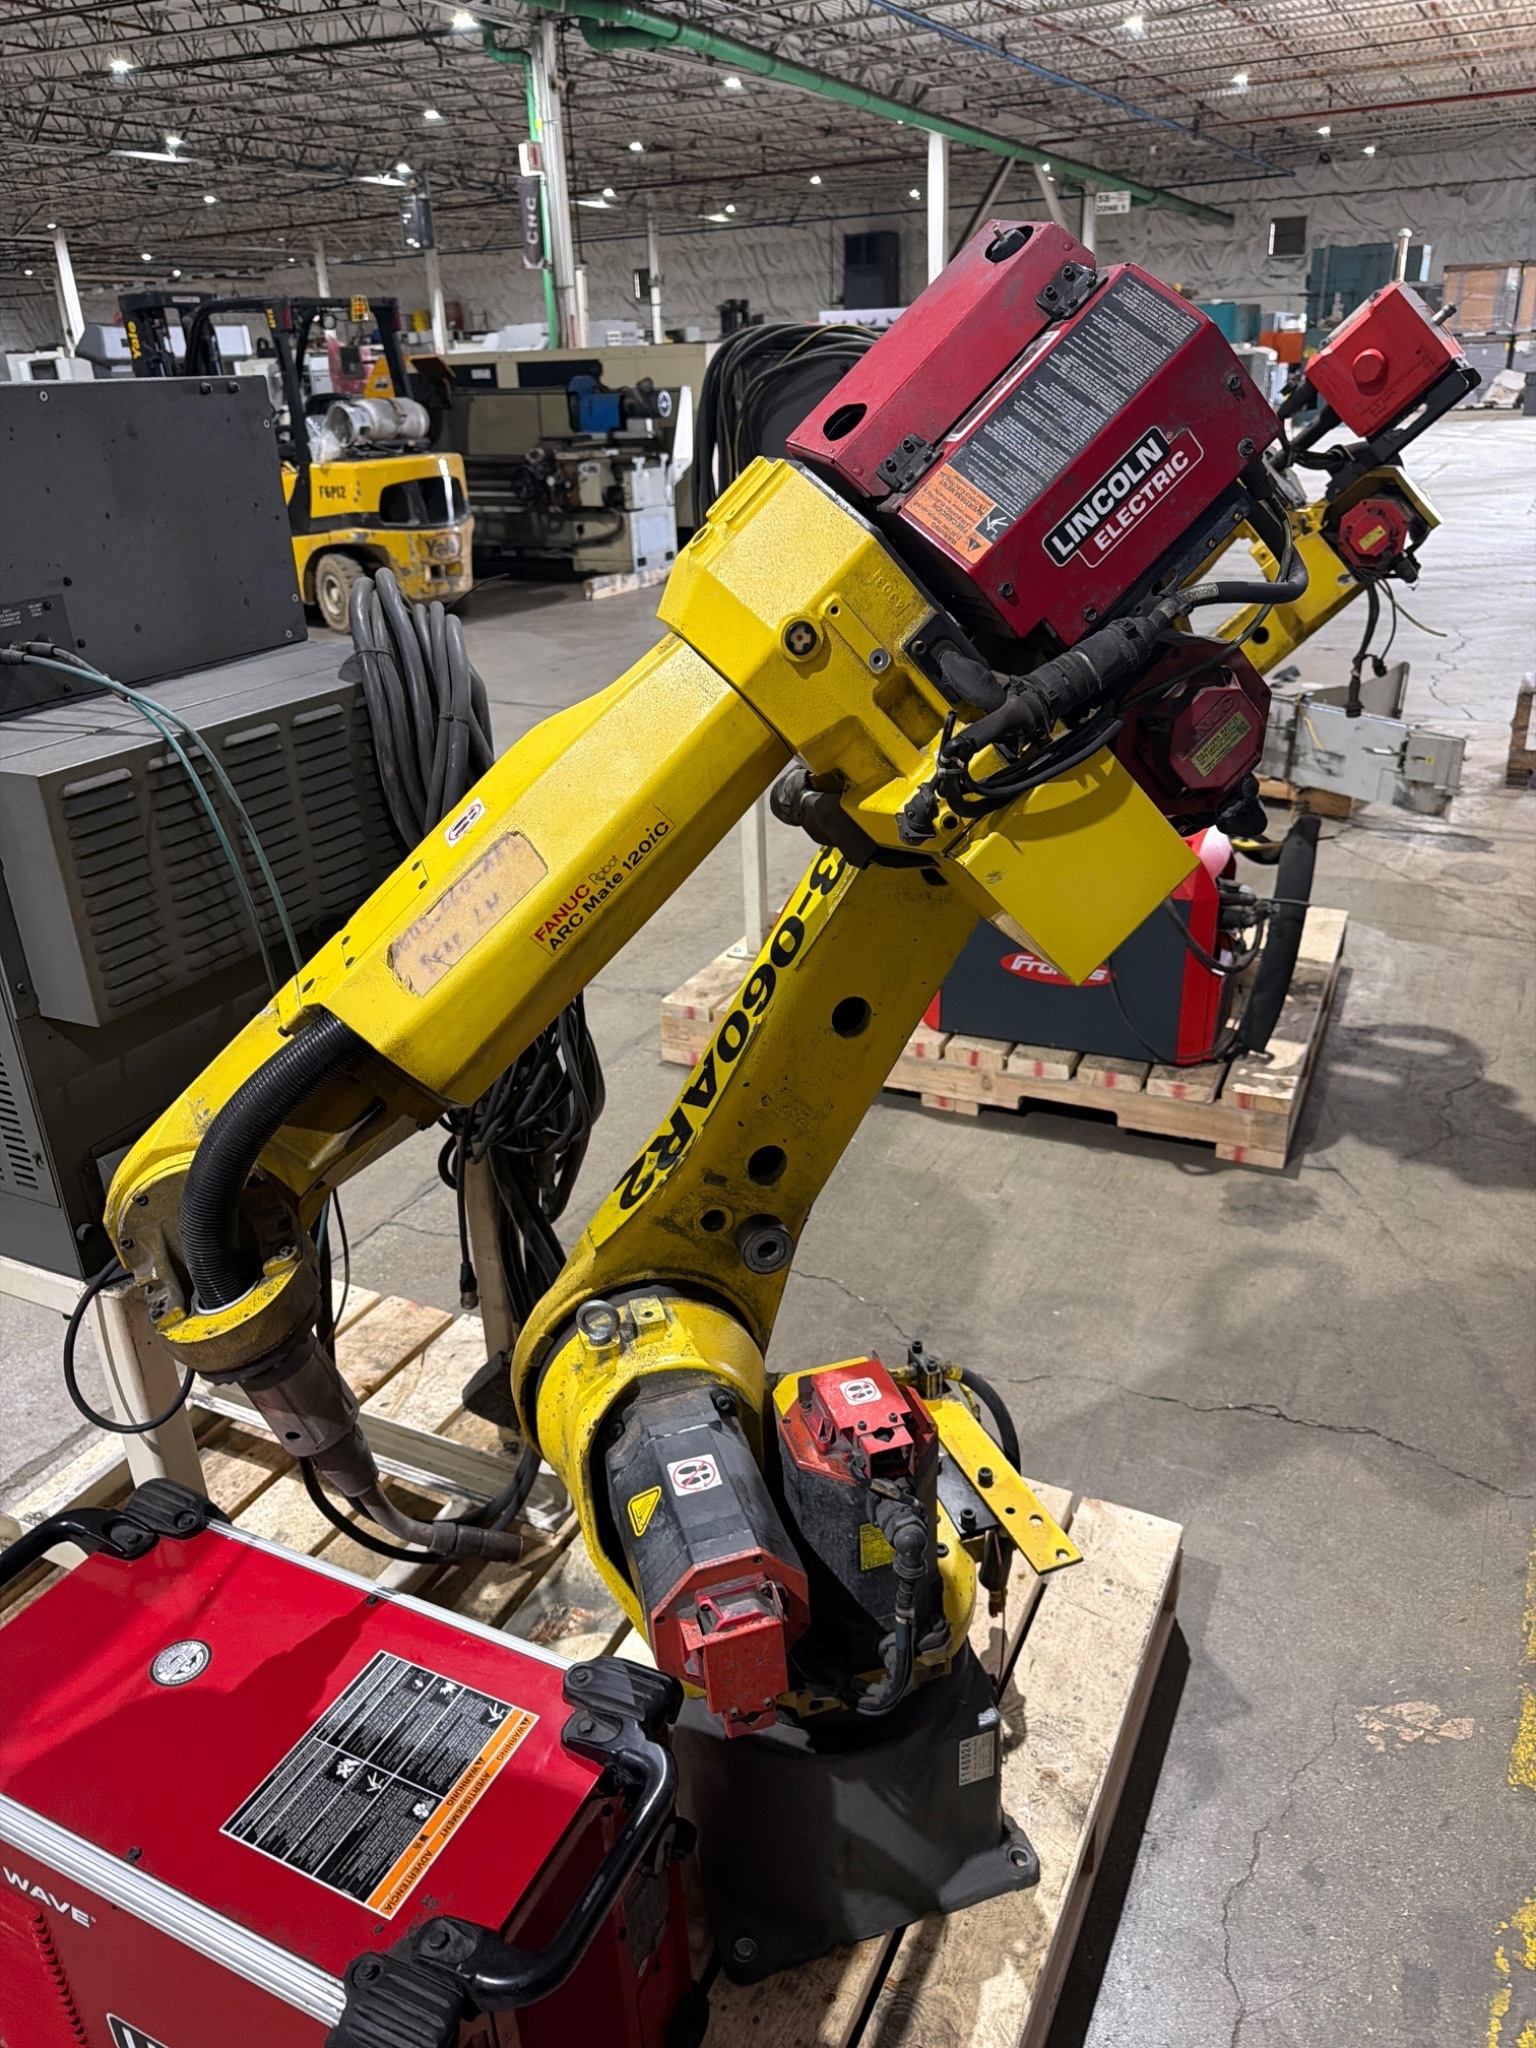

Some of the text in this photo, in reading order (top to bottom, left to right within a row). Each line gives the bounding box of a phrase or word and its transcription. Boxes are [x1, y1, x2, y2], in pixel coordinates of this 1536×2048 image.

[526, 197, 539, 245] CNC
[127, 321, 142, 360] Yale
[938, 478, 985, 517] AVERTISSEMENT
[1052, 437, 1163, 555] LINCOLN
[1095, 450, 1190, 552] ELECTRIC
[929, 521, 958, 545] WARNING
[534, 855, 620, 942] FANUC Robot
[550, 821, 670, 951] ARC Mate 120iC
[1011, 955, 1108, 981] Fros
[614, 846, 846, 1210] 3-060AR2
[494, 1725, 526, 1761] WARNING
[438, 1771, 492, 1838] AVERTISSEMENT
[444, 1765, 480, 1807] WARNUNG
[2, 1866, 91, 1928] WAVE
[383, 1849, 434, 1912] ADVERTENCIA
